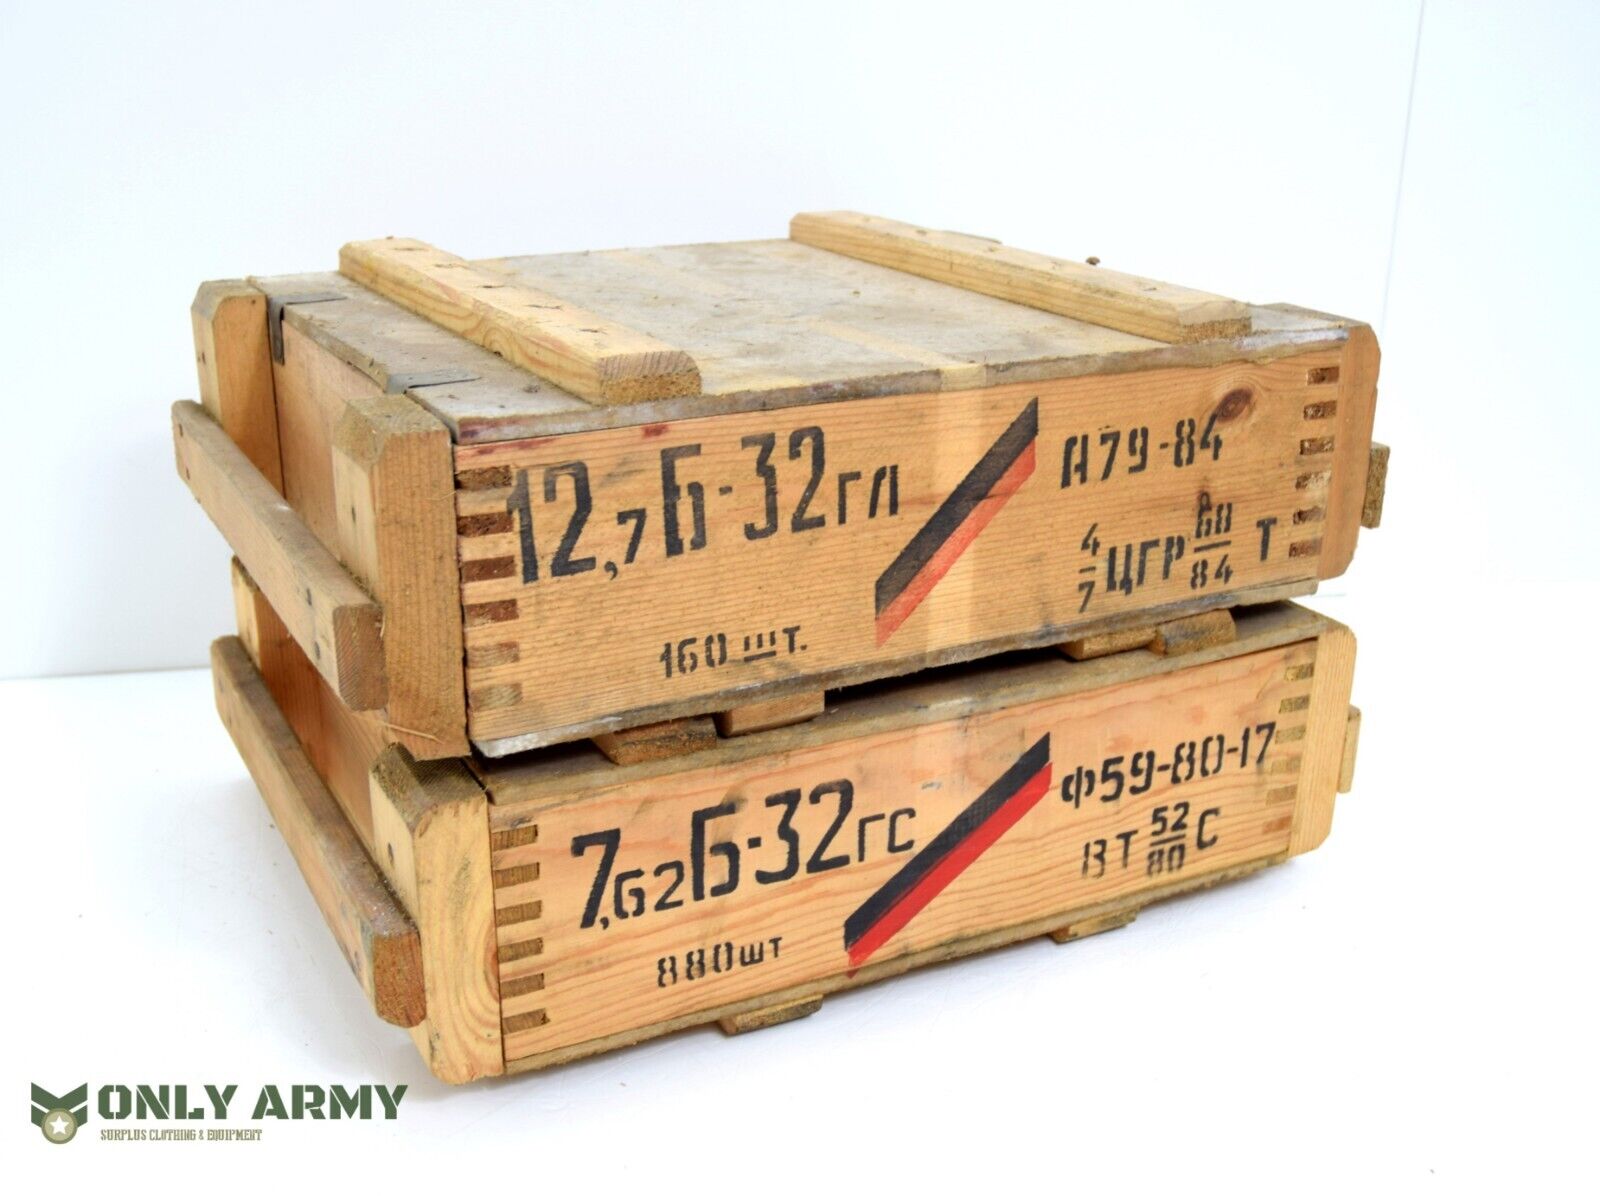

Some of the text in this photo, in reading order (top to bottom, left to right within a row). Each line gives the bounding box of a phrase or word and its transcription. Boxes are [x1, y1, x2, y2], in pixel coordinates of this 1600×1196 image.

[1080, 522, 1100, 556] 4
[1190, 554, 1234, 590] 84
[1078, 581, 1096, 614] 7
[659, 633, 727, 678] 160
[1151, 800, 1191, 836] 52
[1146, 843, 1186, 877] 80
